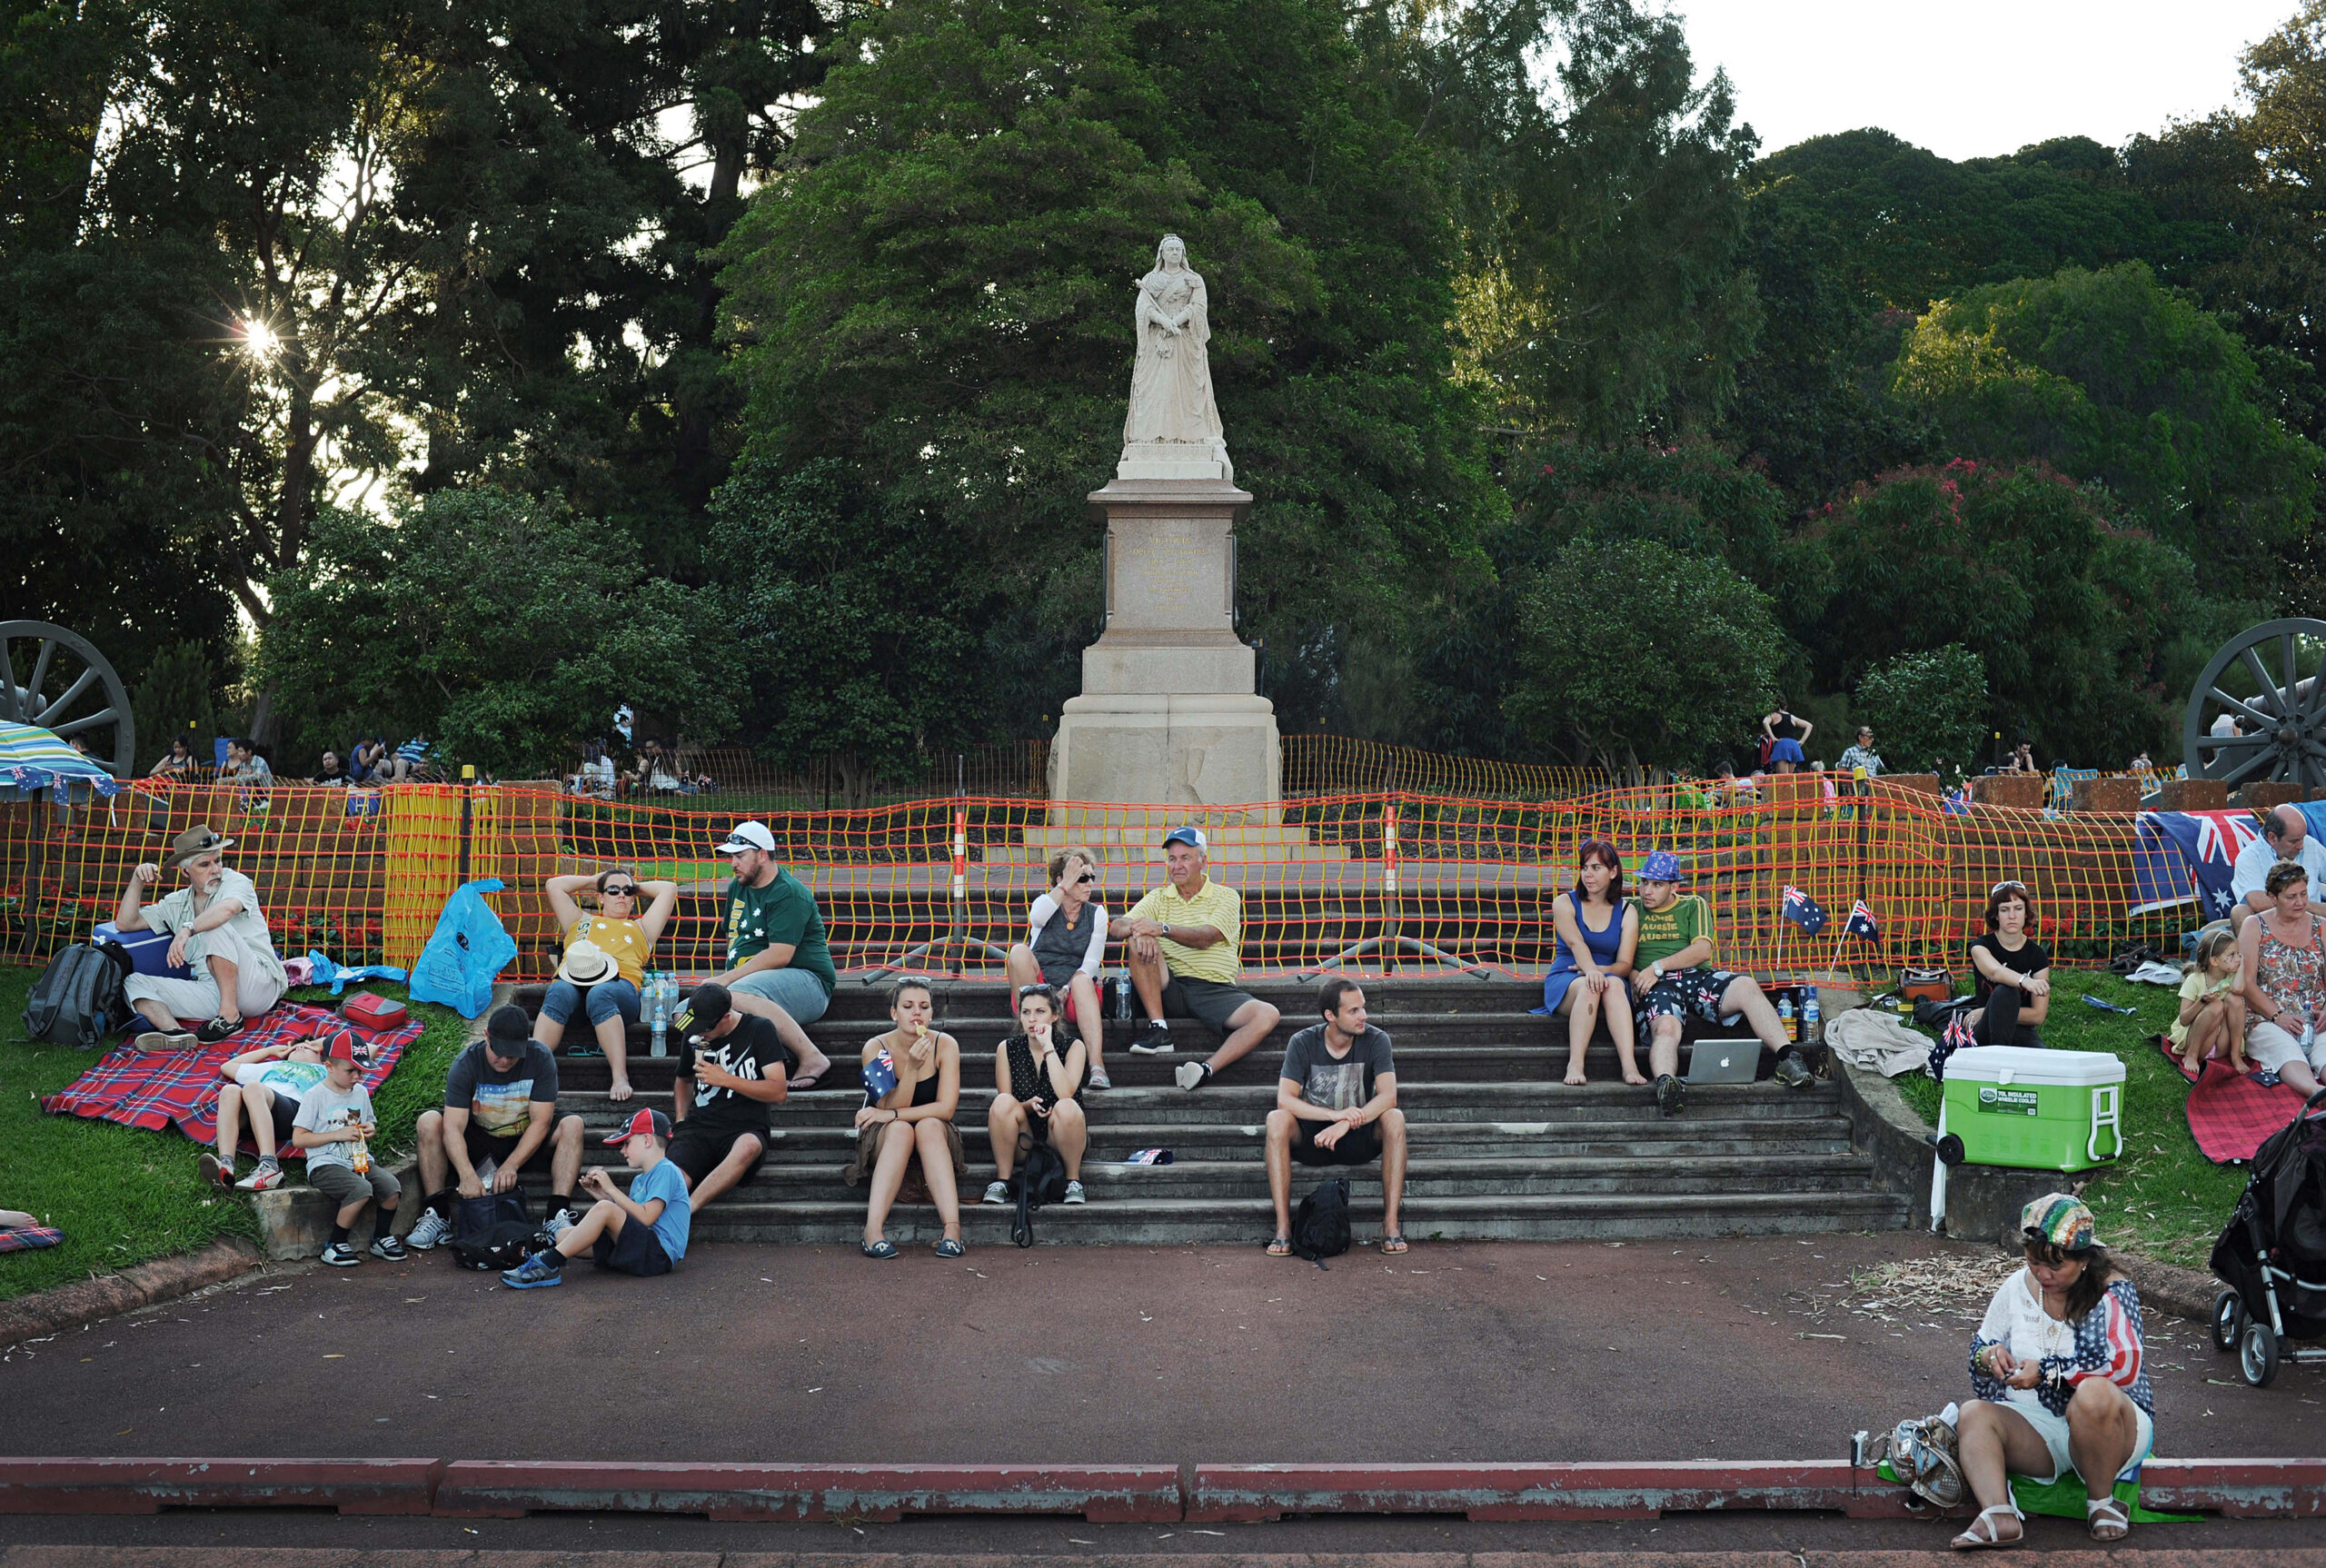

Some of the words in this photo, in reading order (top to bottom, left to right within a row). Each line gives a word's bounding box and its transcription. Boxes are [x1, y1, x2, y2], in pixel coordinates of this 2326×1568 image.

[1641, 922, 1678, 931] AUSSIE
[1638, 933, 1680, 943] AUSSIE
[2008, 1091, 2037, 1099] INSULATED
